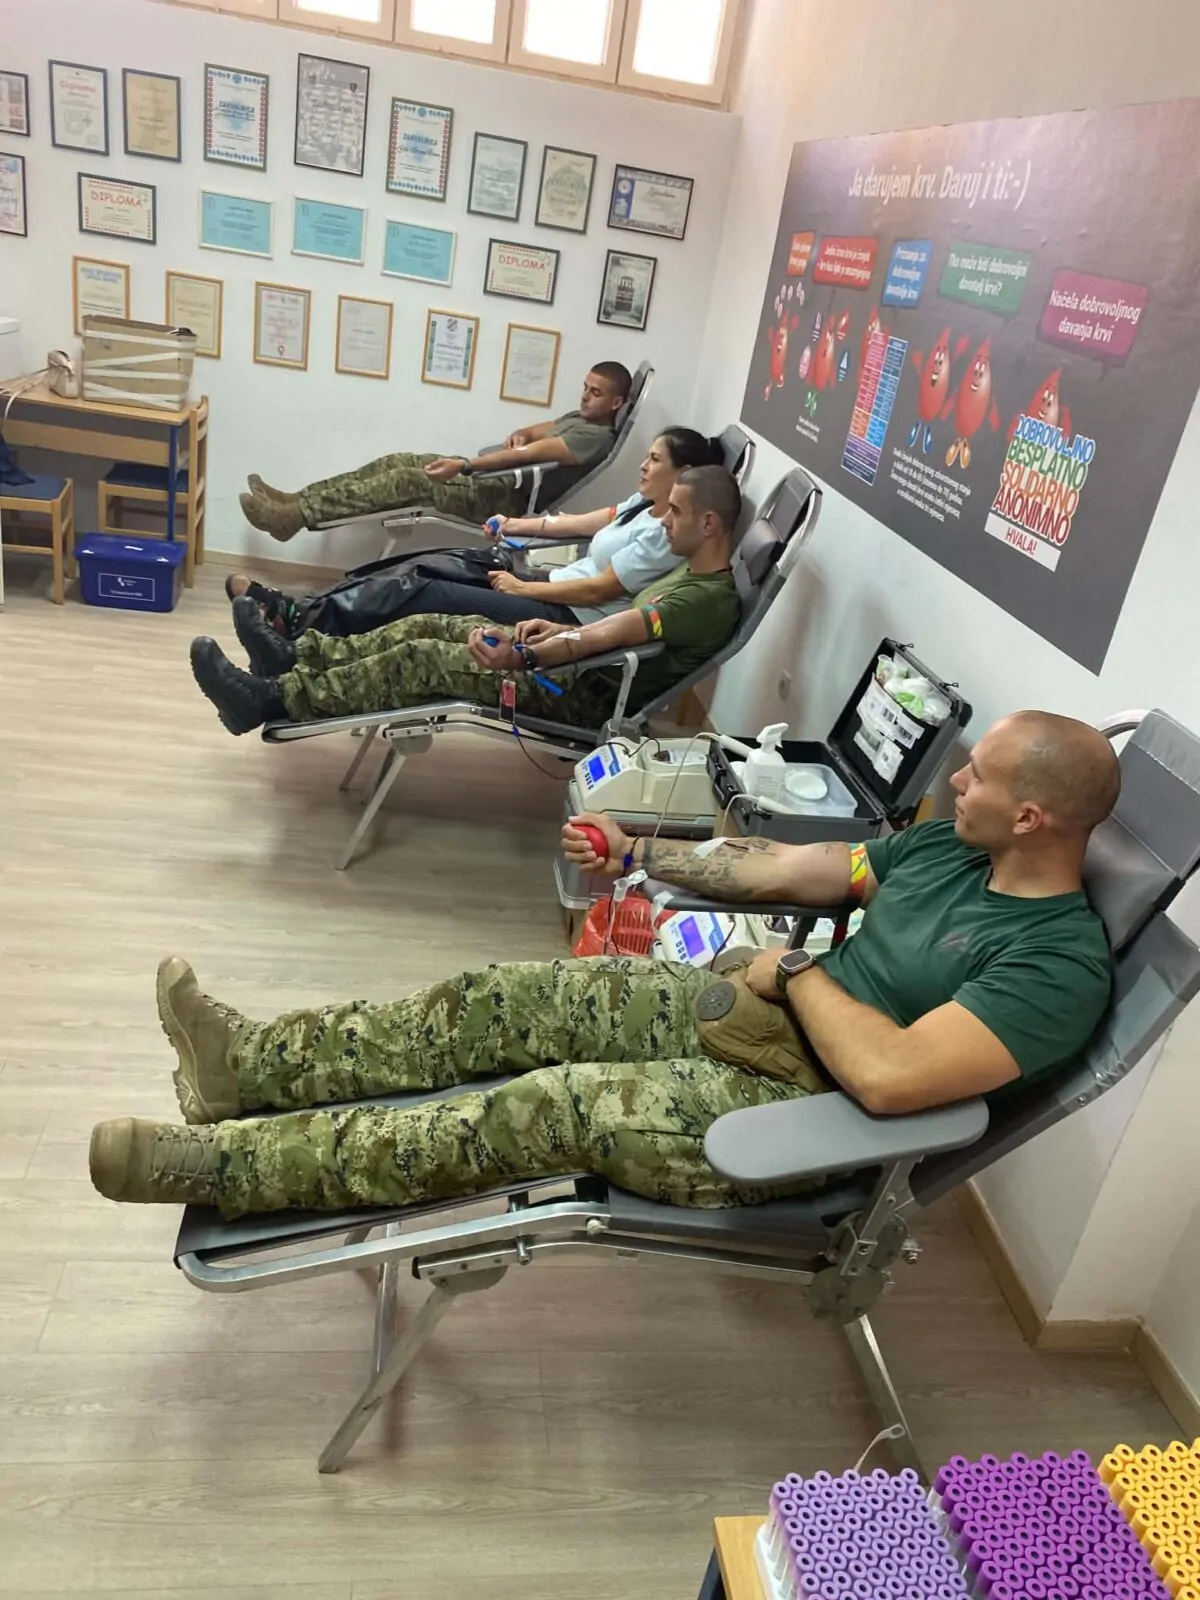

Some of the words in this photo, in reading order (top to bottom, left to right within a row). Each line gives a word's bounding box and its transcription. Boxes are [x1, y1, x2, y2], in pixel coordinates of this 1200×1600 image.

[91, 190, 142, 208] DIPLOMA
[849, 167, 862, 197] Ja
[863, 164, 912, 206] darujem
[911, 163, 936, 199] krv.
[939, 161, 985, 209] Daruj
[982, 161, 996, 200] i
[498, 253, 546, 271] DIPLOMA
[989, 258, 1029, 280] dobrovoljni
[958, 276, 984, 296] davatelj
[984, 280, 1002, 297] krvi?
[1050, 290, 1079, 311] Načela
[1079, 293, 1141, 325] dobrovoljnog
[1058, 317, 1093, 341] davanja
[1093, 320, 1115, 343] krvi
[1015, 415, 1095, 463] DOBROVOLJNO
[1007, 438, 1087, 489] BESPLATNO
[1003, 461, 1079, 516] SOLIDARNO
[994, 484, 1070, 543] ANONIMNO
[1006, 529, 1038, 556] HVALA!
